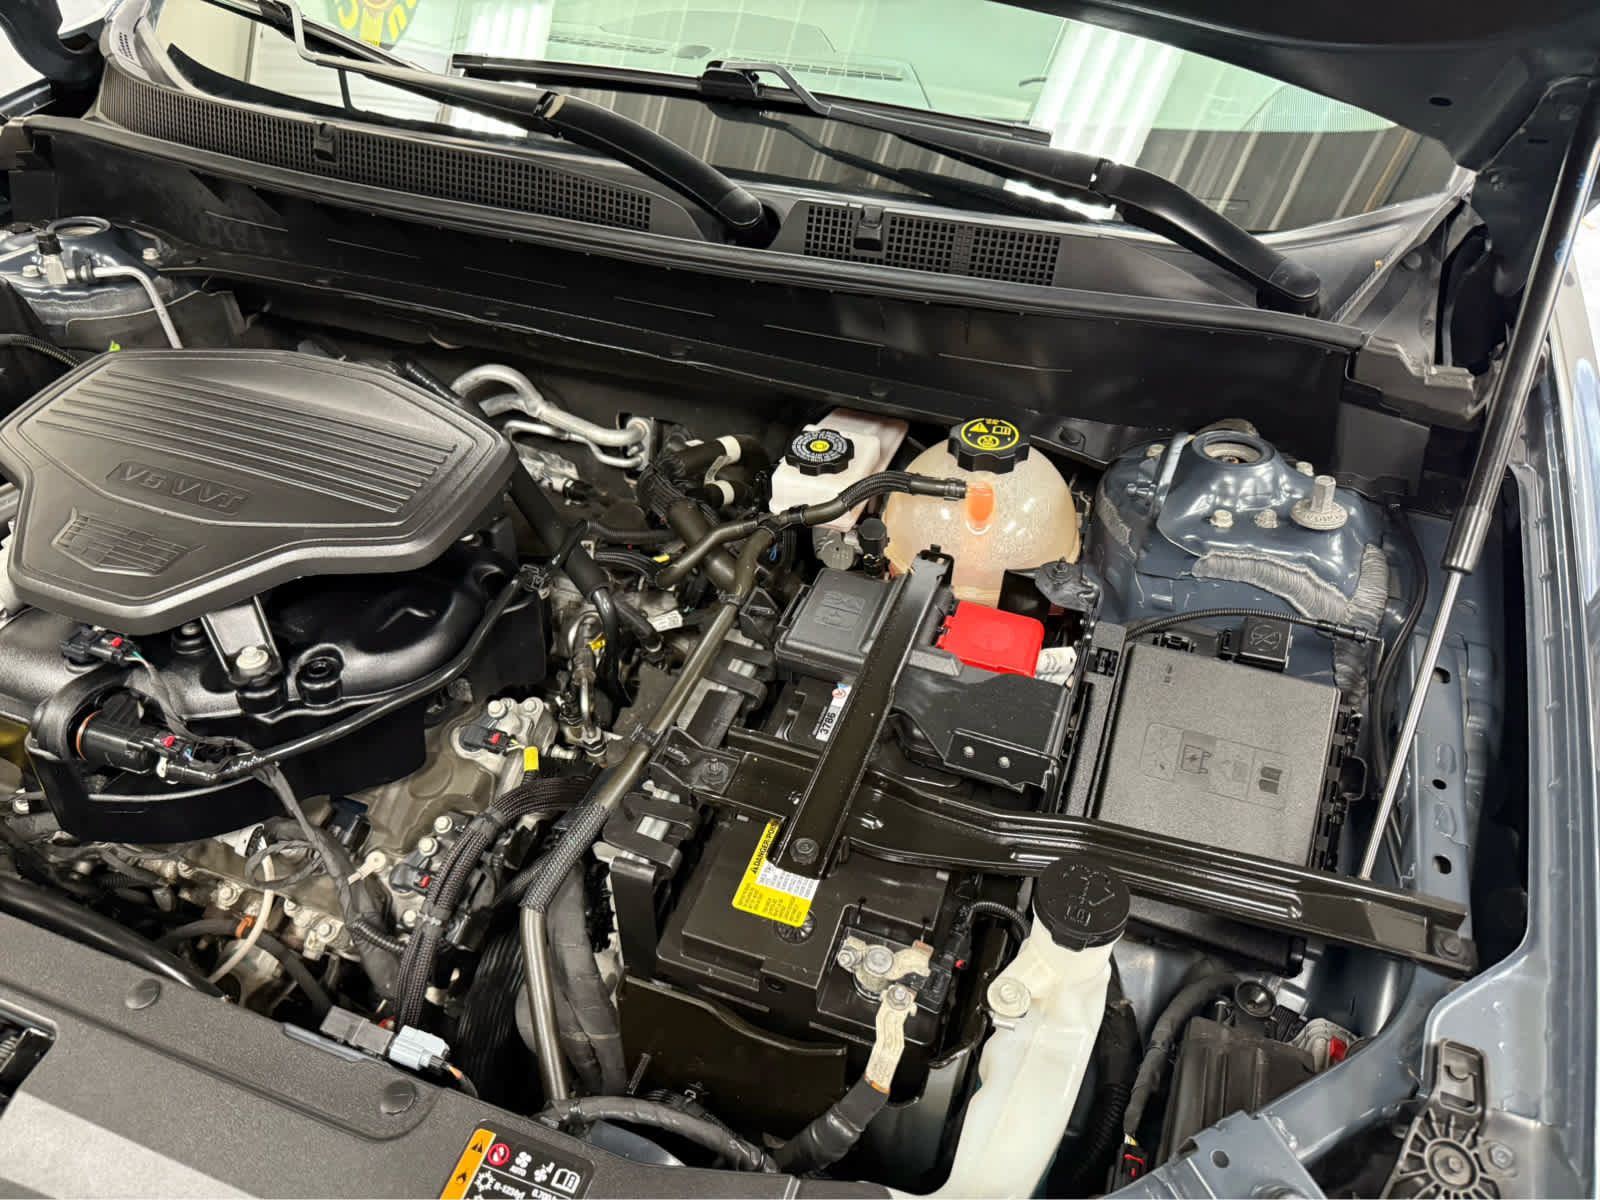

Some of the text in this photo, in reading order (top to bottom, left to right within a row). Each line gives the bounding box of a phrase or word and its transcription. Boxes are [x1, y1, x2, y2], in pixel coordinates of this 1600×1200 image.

[120, 464, 246, 508] V6 VVT
[819, 712, 836, 735] 3786
